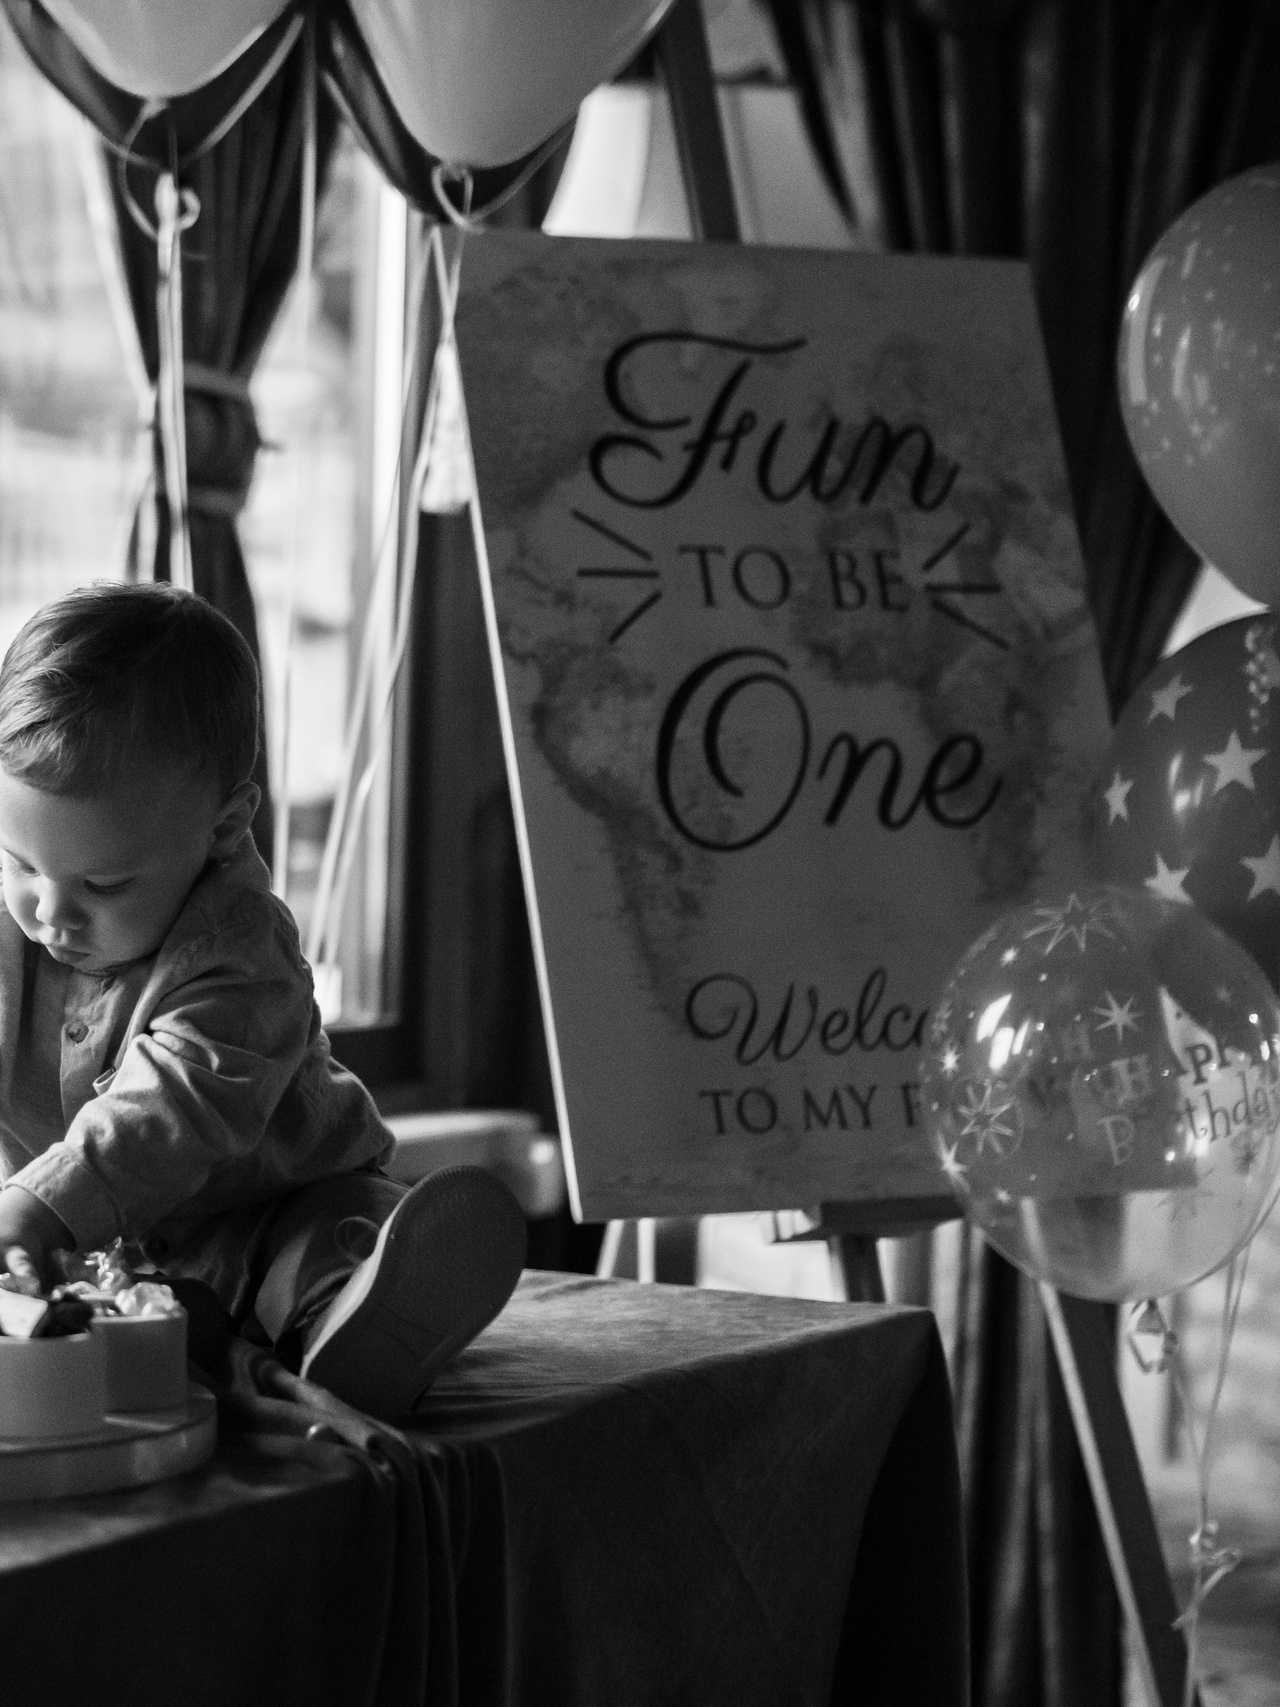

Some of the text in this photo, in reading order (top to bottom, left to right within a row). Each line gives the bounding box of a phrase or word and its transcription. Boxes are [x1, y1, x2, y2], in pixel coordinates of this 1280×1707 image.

[588, 329, 962, 512] Fun
[678, 543, 910, 613] TO BE
[655, 645, 1005, 854] One
[684, 965, 930, 1067] Welc
[699, 1086, 778, 1136] TO
[802, 1084, 877, 1132] MY
